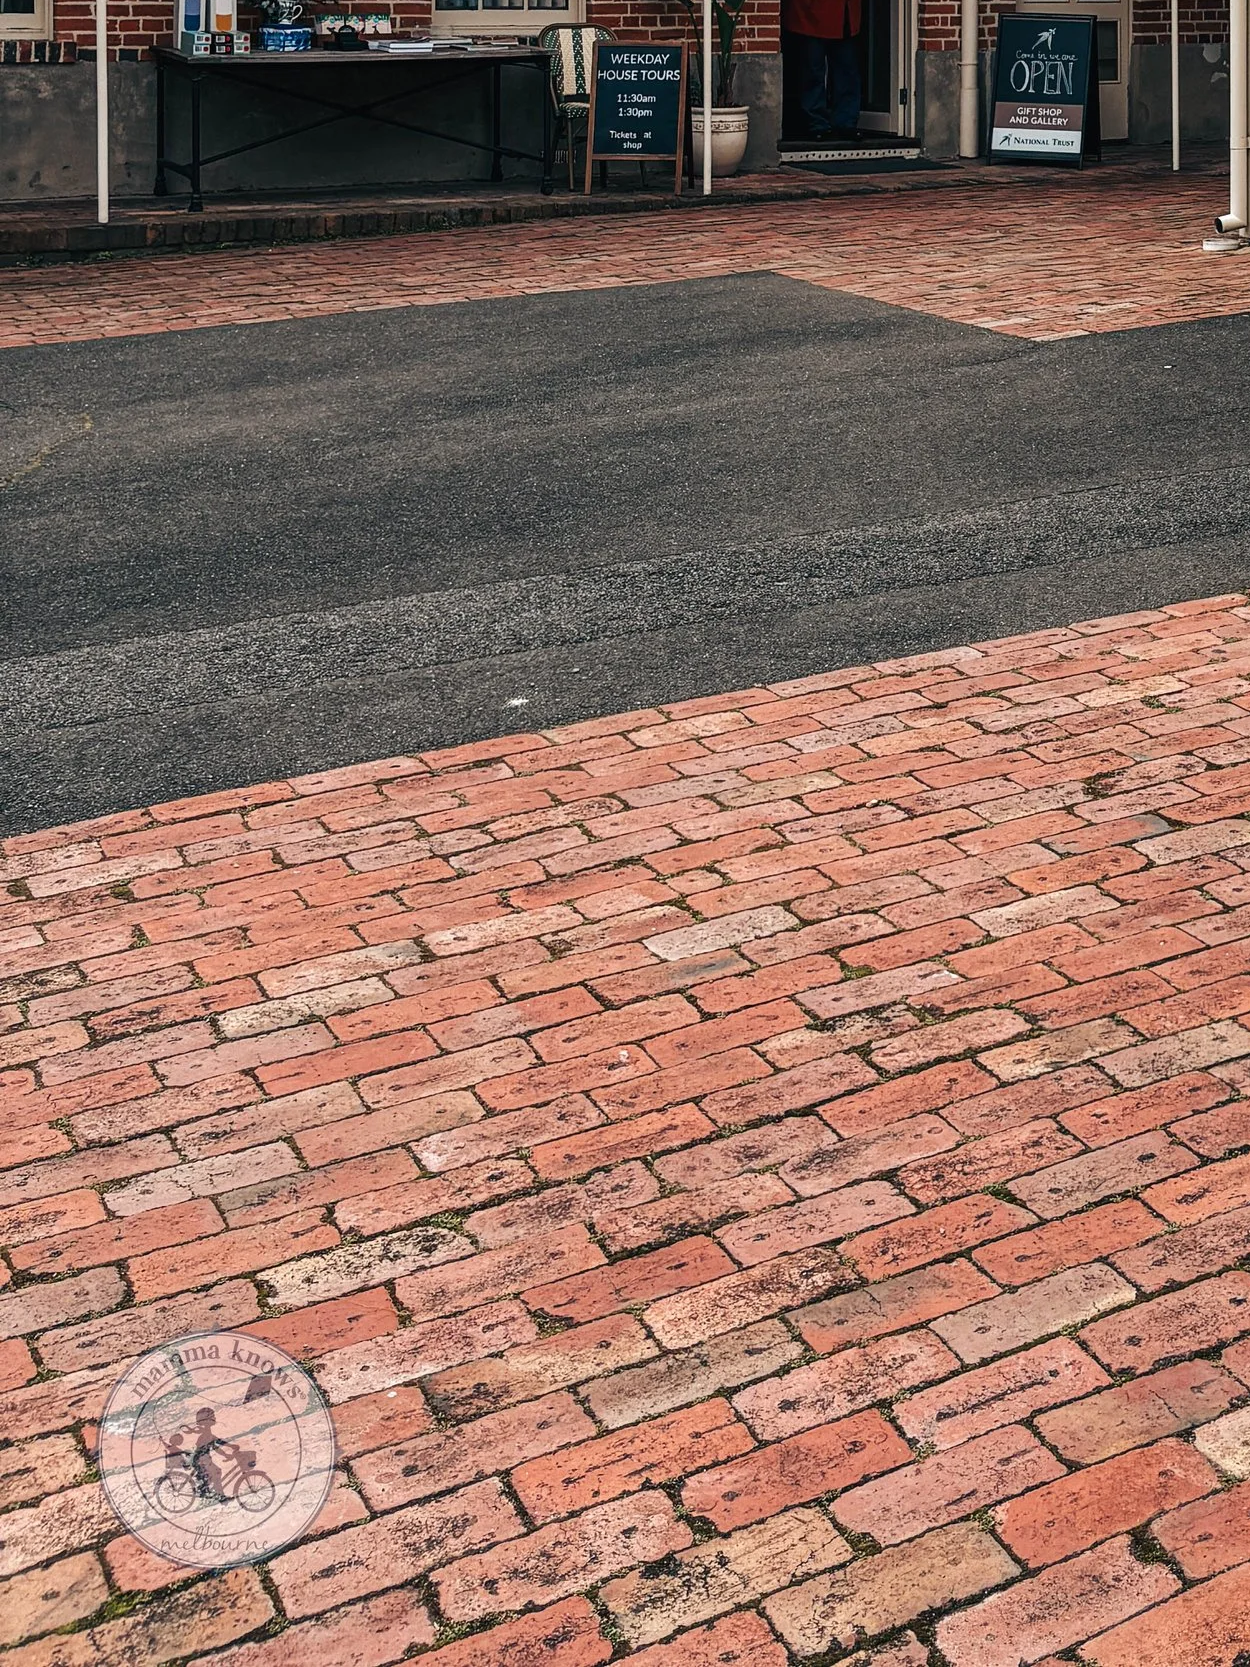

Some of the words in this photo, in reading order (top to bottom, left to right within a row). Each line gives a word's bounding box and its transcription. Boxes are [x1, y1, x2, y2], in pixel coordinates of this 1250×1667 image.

[611, 54, 670, 64] WEEKDAY
[598, 70, 638, 80] HOUSE
[640, 70, 680, 80] TOURS
[1010, 60, 1073, 94] OPEN
[617, 94, 656, 102] 11:30am
[619, 108, 652, 118] 1:30pm
[1017, 107, 1036, 115] GIFT
[1038, 108, 1062, 116] SHOP
[1010, 116, 1029, 124] AND
[1031, 117, 1068, 126] GALLERY
[610, 130, 637, 139] Tickets
[623, 141, 642, 150] shop
[1014, 137, 1049, 145] NATIONAL
[1052, 138, 1074, 147] TRUST
